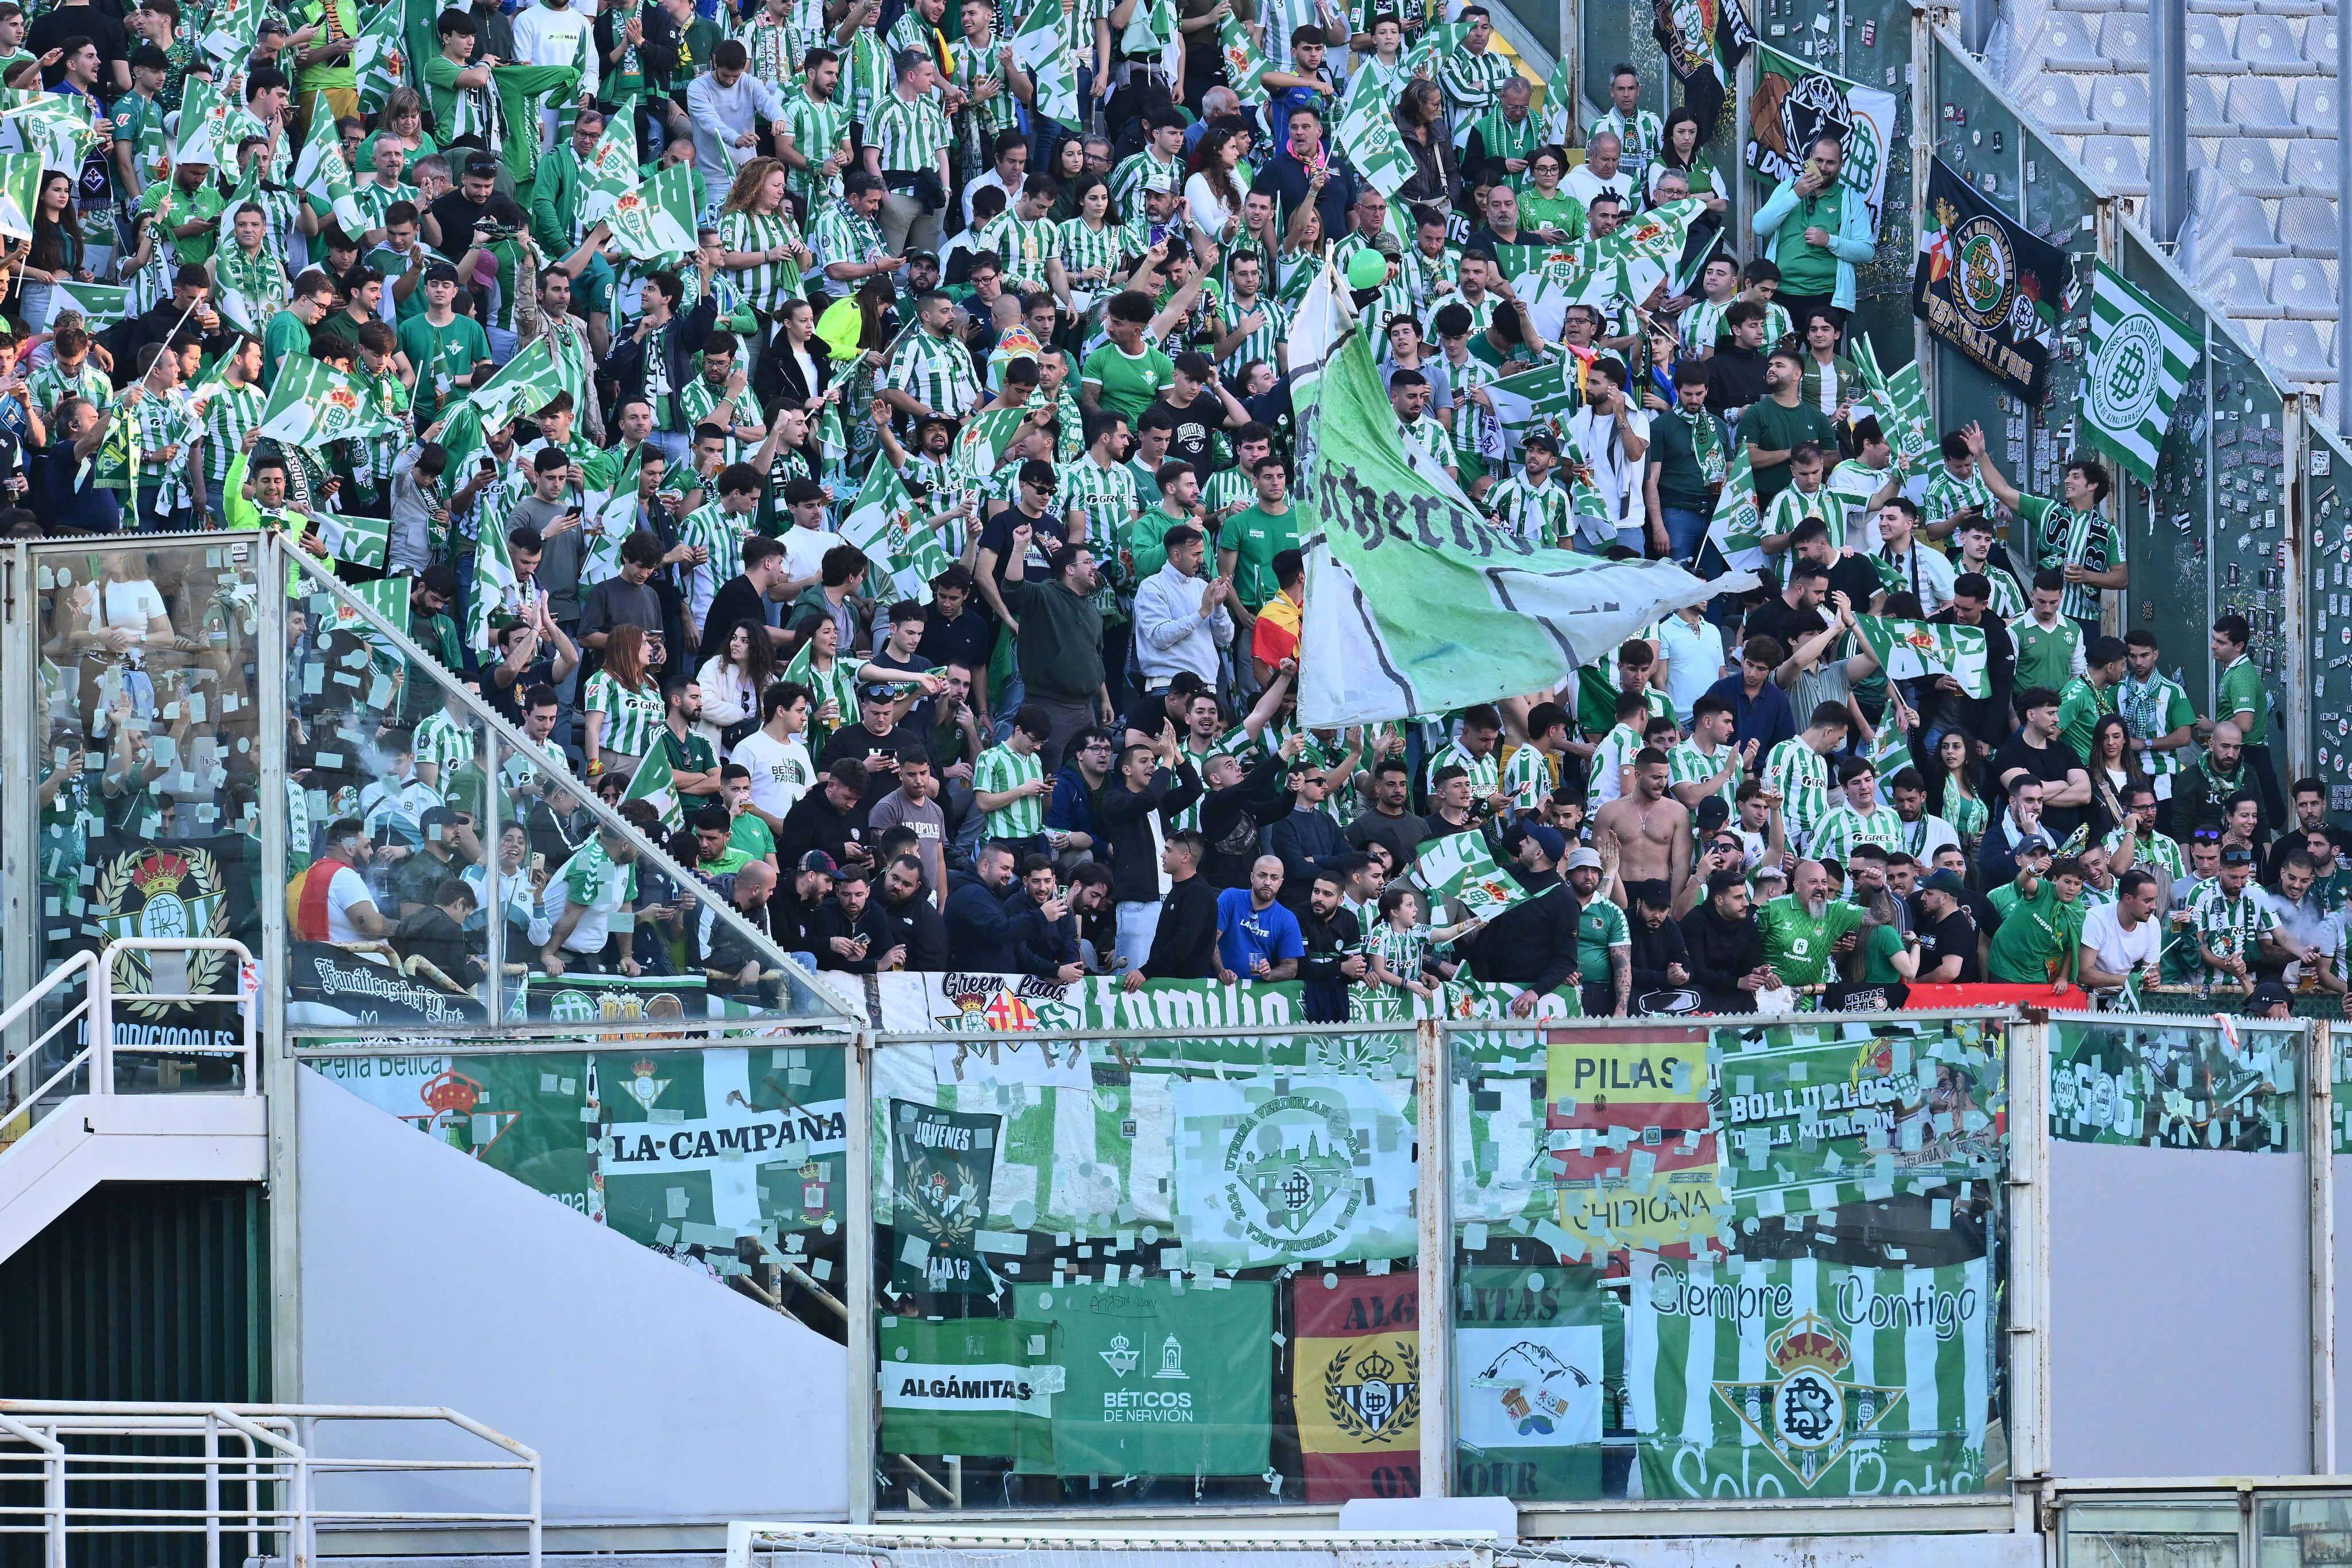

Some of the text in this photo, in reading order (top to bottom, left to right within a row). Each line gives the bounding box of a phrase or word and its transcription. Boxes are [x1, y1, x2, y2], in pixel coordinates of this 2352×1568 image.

[2125, 319, 2158, 355] CAJONEROS
[2096, 390, 2104, 410] JUAN
[2106, 404, 2144, 424] AZNALFARACHE
[1177, 423, 1206, 443] ADIDAS
[771, 765, 794, 775] BETIS
[774, 774, 795, 783] FANS
[1783, 951, 1813, 963] finetwork
[940, 971, 1005, 998] Green
[1844, 988, 1885, 1004] ULTRAS
[1573, 1056, 1682, 1090] PILAS
[2056, 1081, 2073, 1097] 1907
[610, 1112, 845, 1164] LA CAMPANA
[914, 1114, 970, 1151] JÓVENES
[1224, 1117, 1258, 1171] UTRERA
[1573, 1188, 1710, 1230] CHIPIONA
[1649, 1263, 1976, 1339] Siempre Contigo
[899, 1374, 1035, 1401] ALGÁMITAS
[1103, 1387, 1192, 1408] BÉTICOS
[1103, 1407, 1193, 1422] DE NERVIÓN
